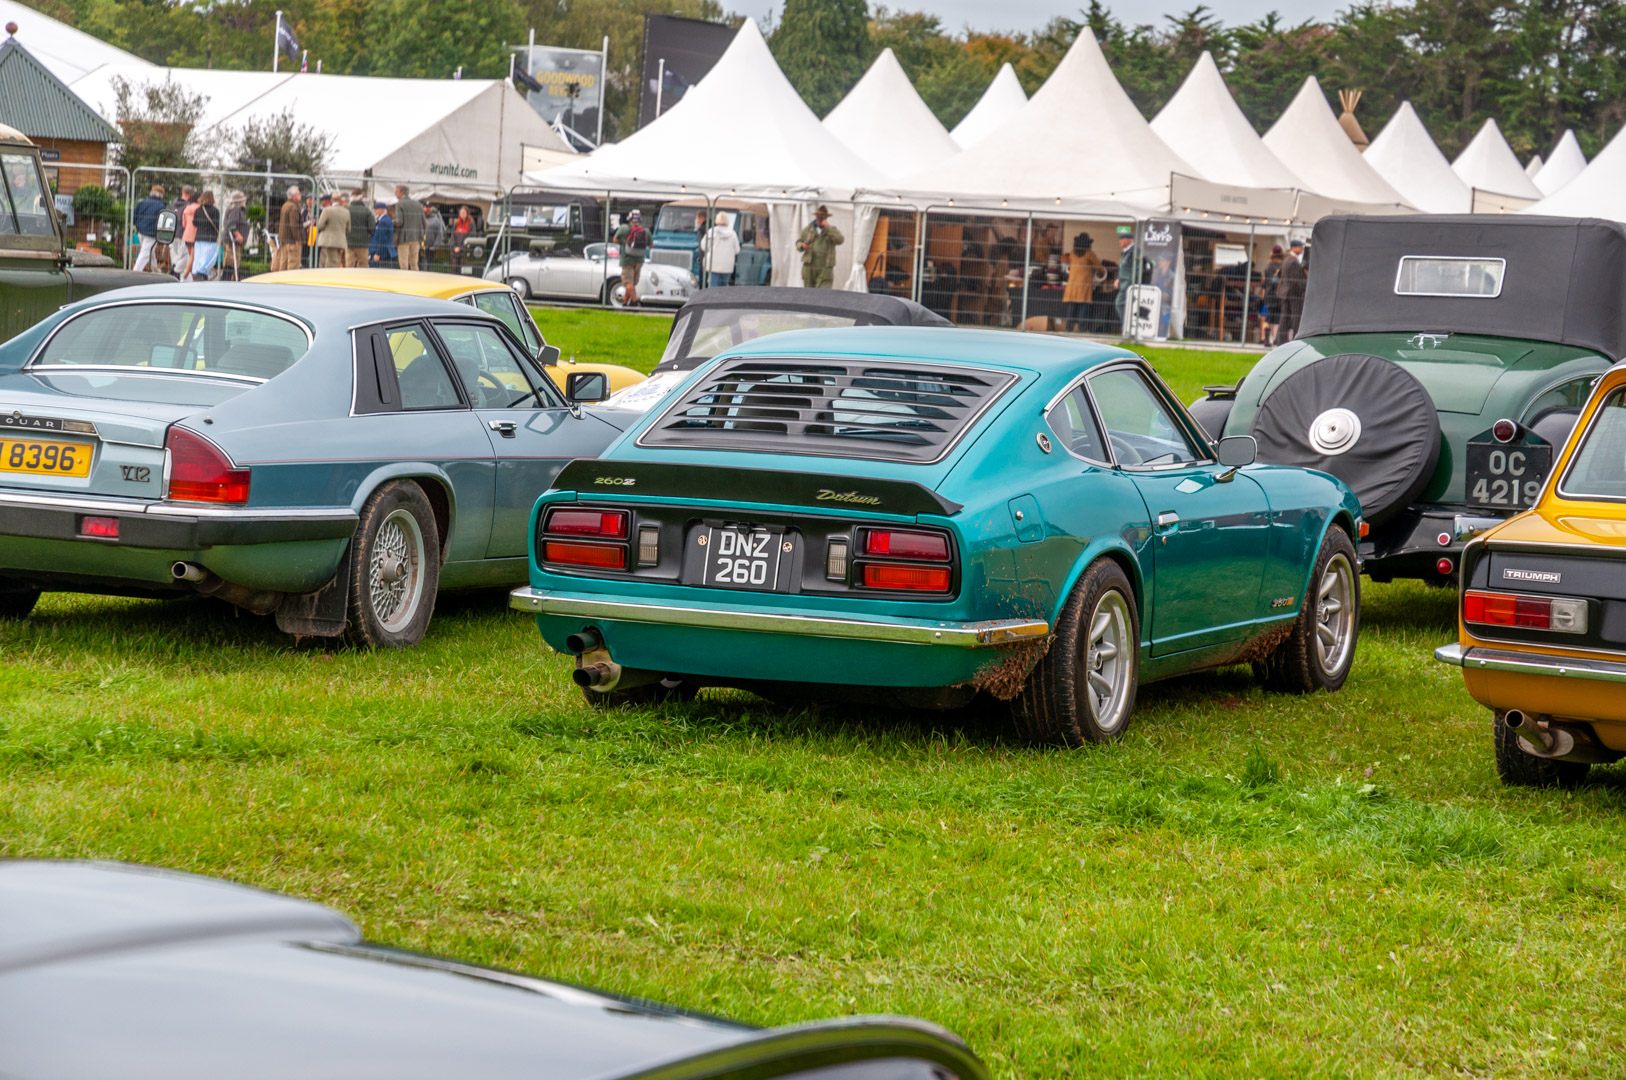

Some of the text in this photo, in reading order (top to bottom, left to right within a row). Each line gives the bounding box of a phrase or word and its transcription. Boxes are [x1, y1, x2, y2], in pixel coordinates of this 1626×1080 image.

[537, 70, 595, 88] GOODWOOD
[430, 163, 478, 179] arunltd.com
[9, 443, 76, 471] 8396
[1489, 450, 1526, 476] OC
[594, 476, 636, 486] 260Z
[1472, 478, 1541, 505] 4219
[816, 489, 883, 506] Datsun
[718, 531, 769, 558] DNZ
[715, 558, 768, 585] 260
[1506, 570, 1559, 582] TRIUMPH
